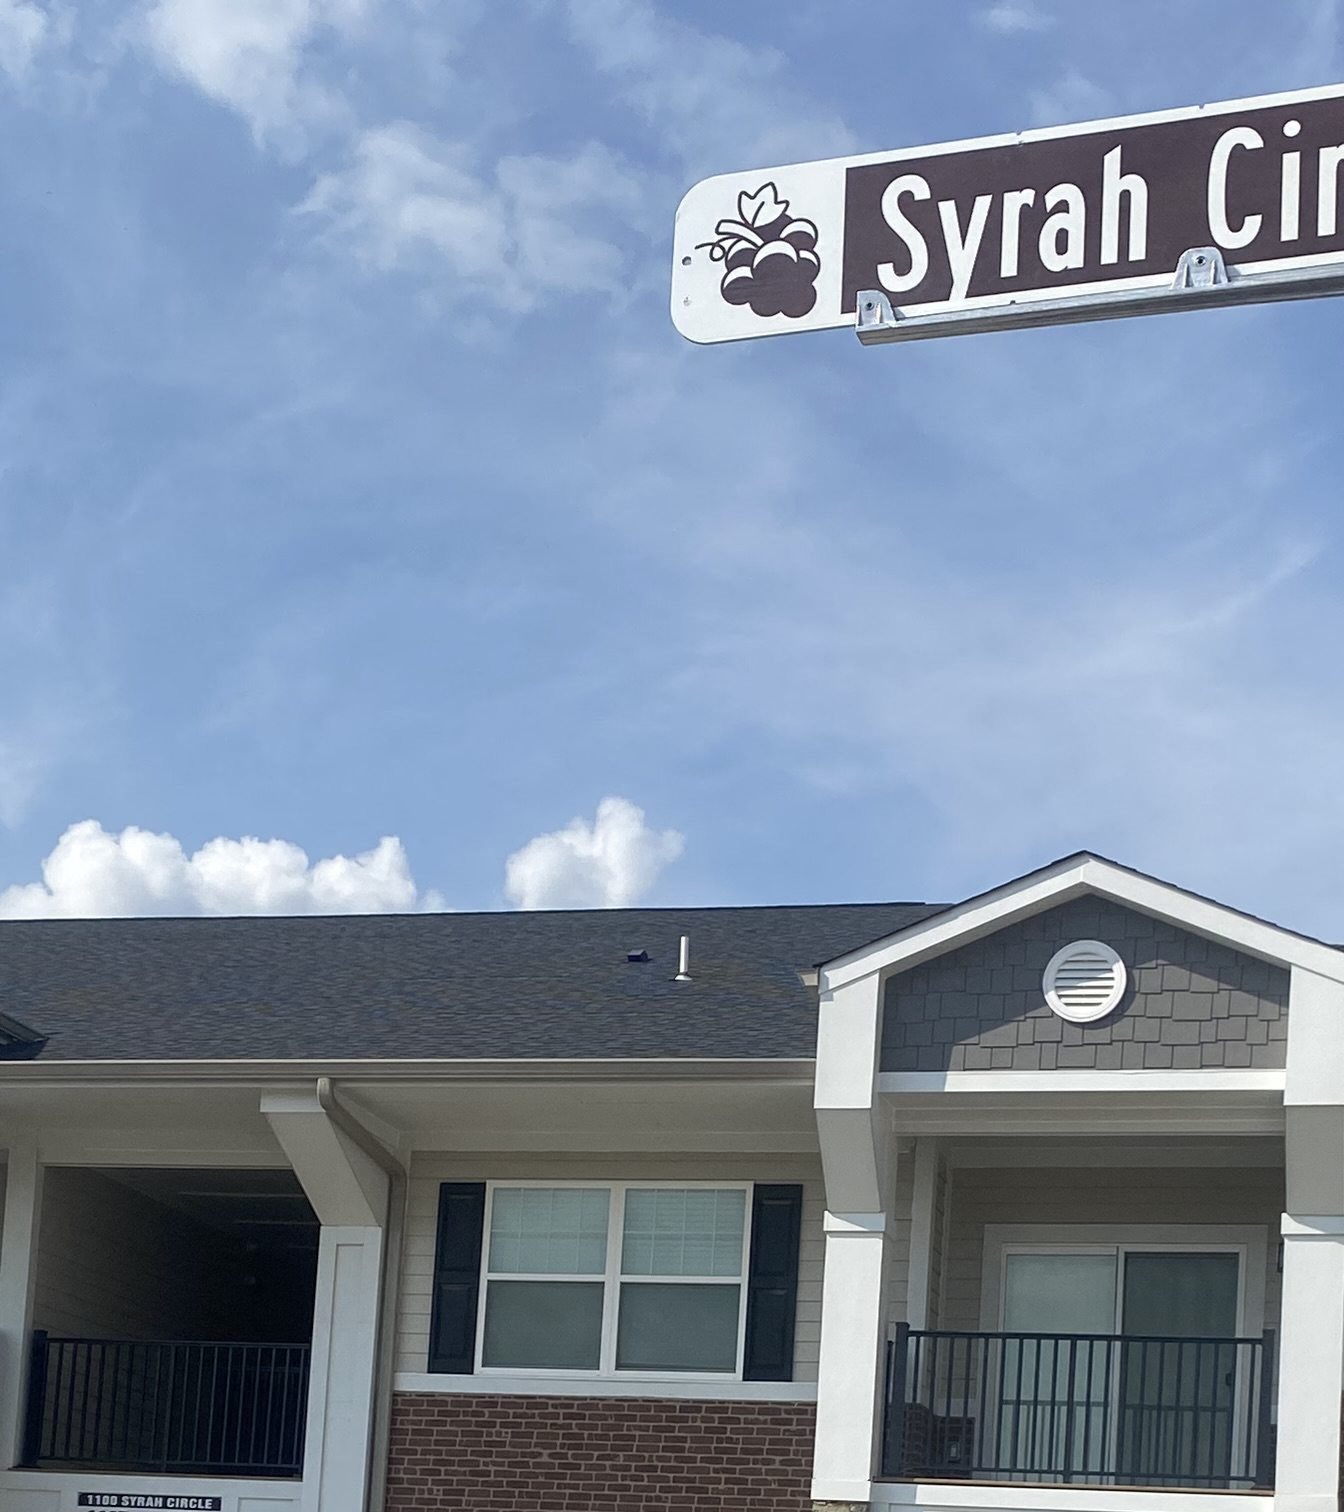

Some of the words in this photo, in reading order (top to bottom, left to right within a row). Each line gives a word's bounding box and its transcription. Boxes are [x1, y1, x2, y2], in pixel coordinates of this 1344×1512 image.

[876, 143, 1150, 300] Syrah
[87, 1494, 117, 1506] 1100
[120, 1495, 163, 1507] SYRAH
[166, 1497, 213, 1509] CIRCLE
